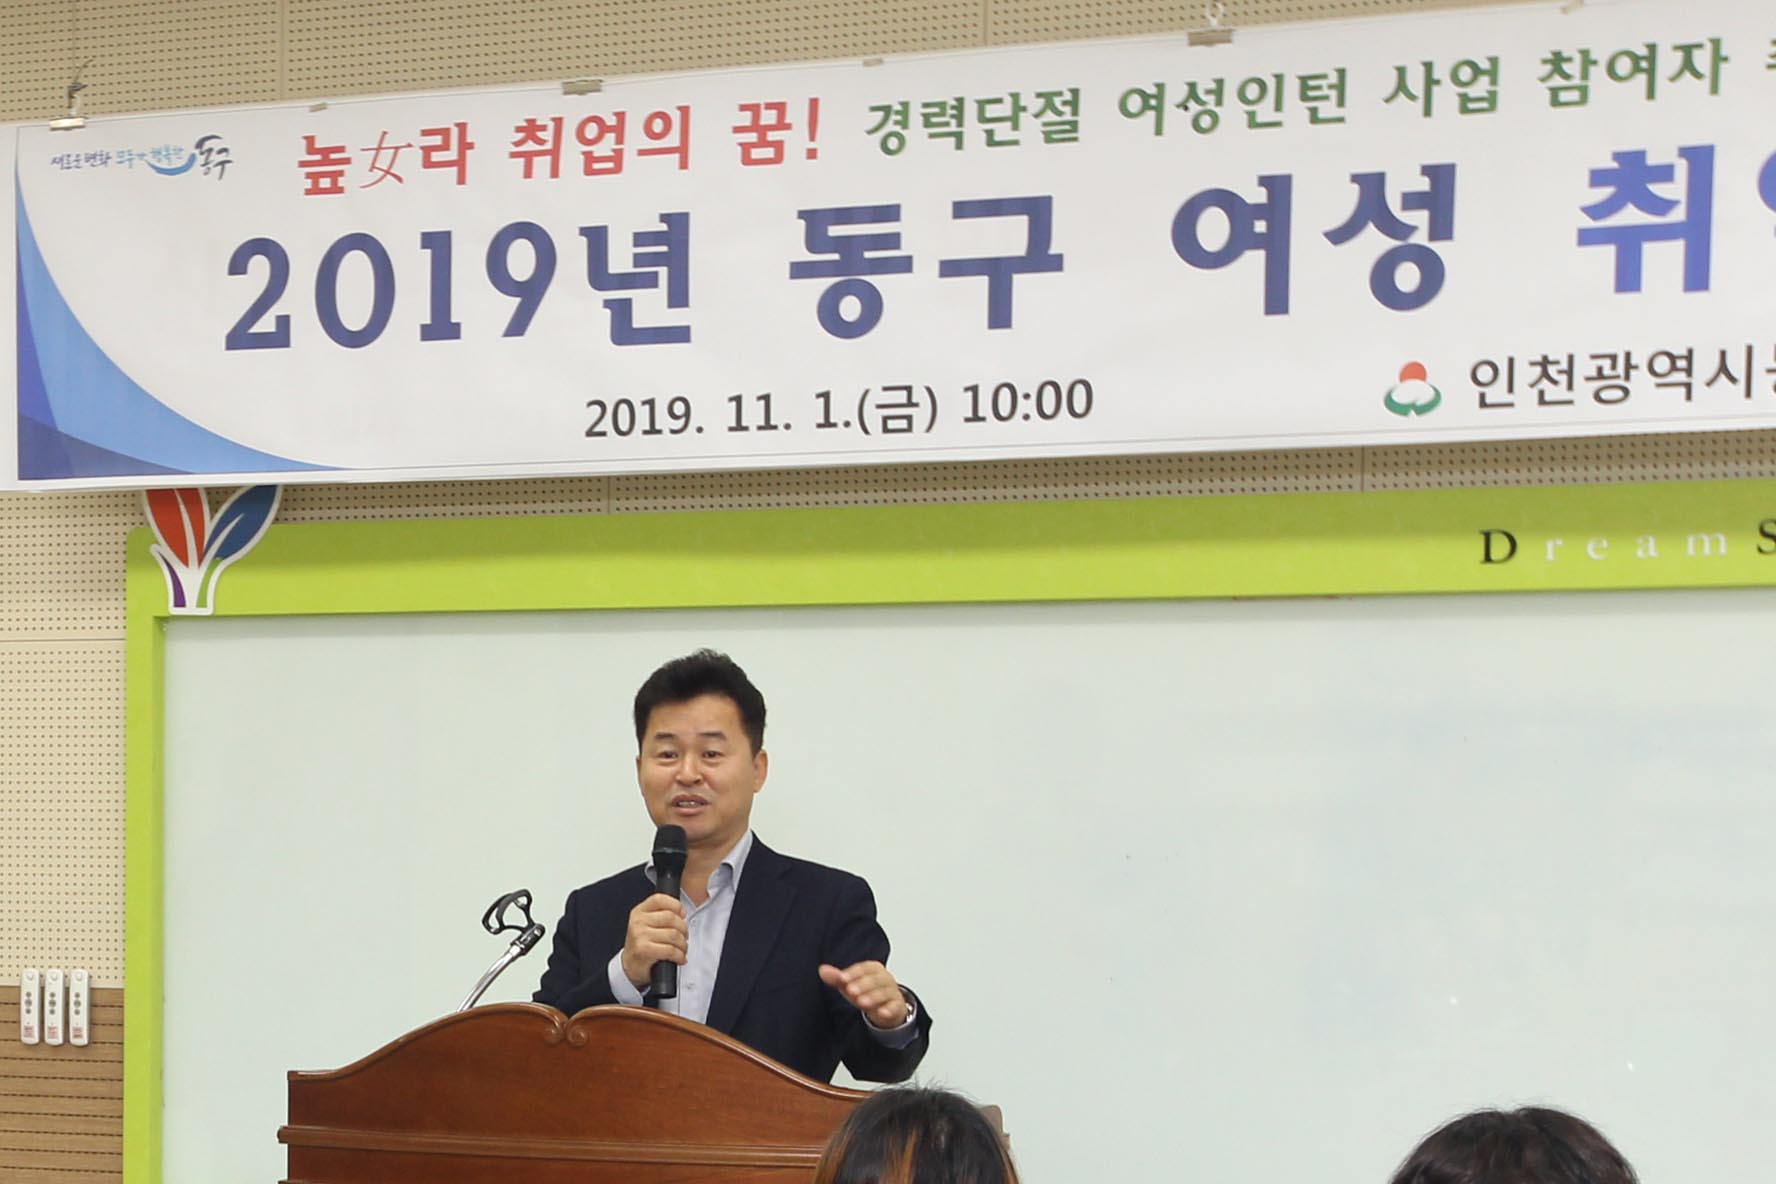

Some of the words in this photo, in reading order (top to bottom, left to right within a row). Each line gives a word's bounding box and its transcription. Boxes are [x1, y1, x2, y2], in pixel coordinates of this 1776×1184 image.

[297, 121, 475, 196] 높女라
[508, 105, 691, 180] 취업의
[731, 97, 821, 167] 꿈!
[865, 87, 1082, 157] 경력단절
[1118, 67, 1348, 137] 여성인턴
[1382, 55, 1501, 119] 사업
[1537, 37, 1730, 108] 참여자
[224, 211, 692, 352] 2019년
[787, 194, 1065, 341] 동구
[1170, 162, 1458, 317] 여성
[1576, 143, 1776, 294] 취
[584, 395, 705, 438] 2019.
[727, 392, 792, 433] 11.
[962, 378, 1094, 424] 10:00
[1478, 528, 1729, 565] Dream
